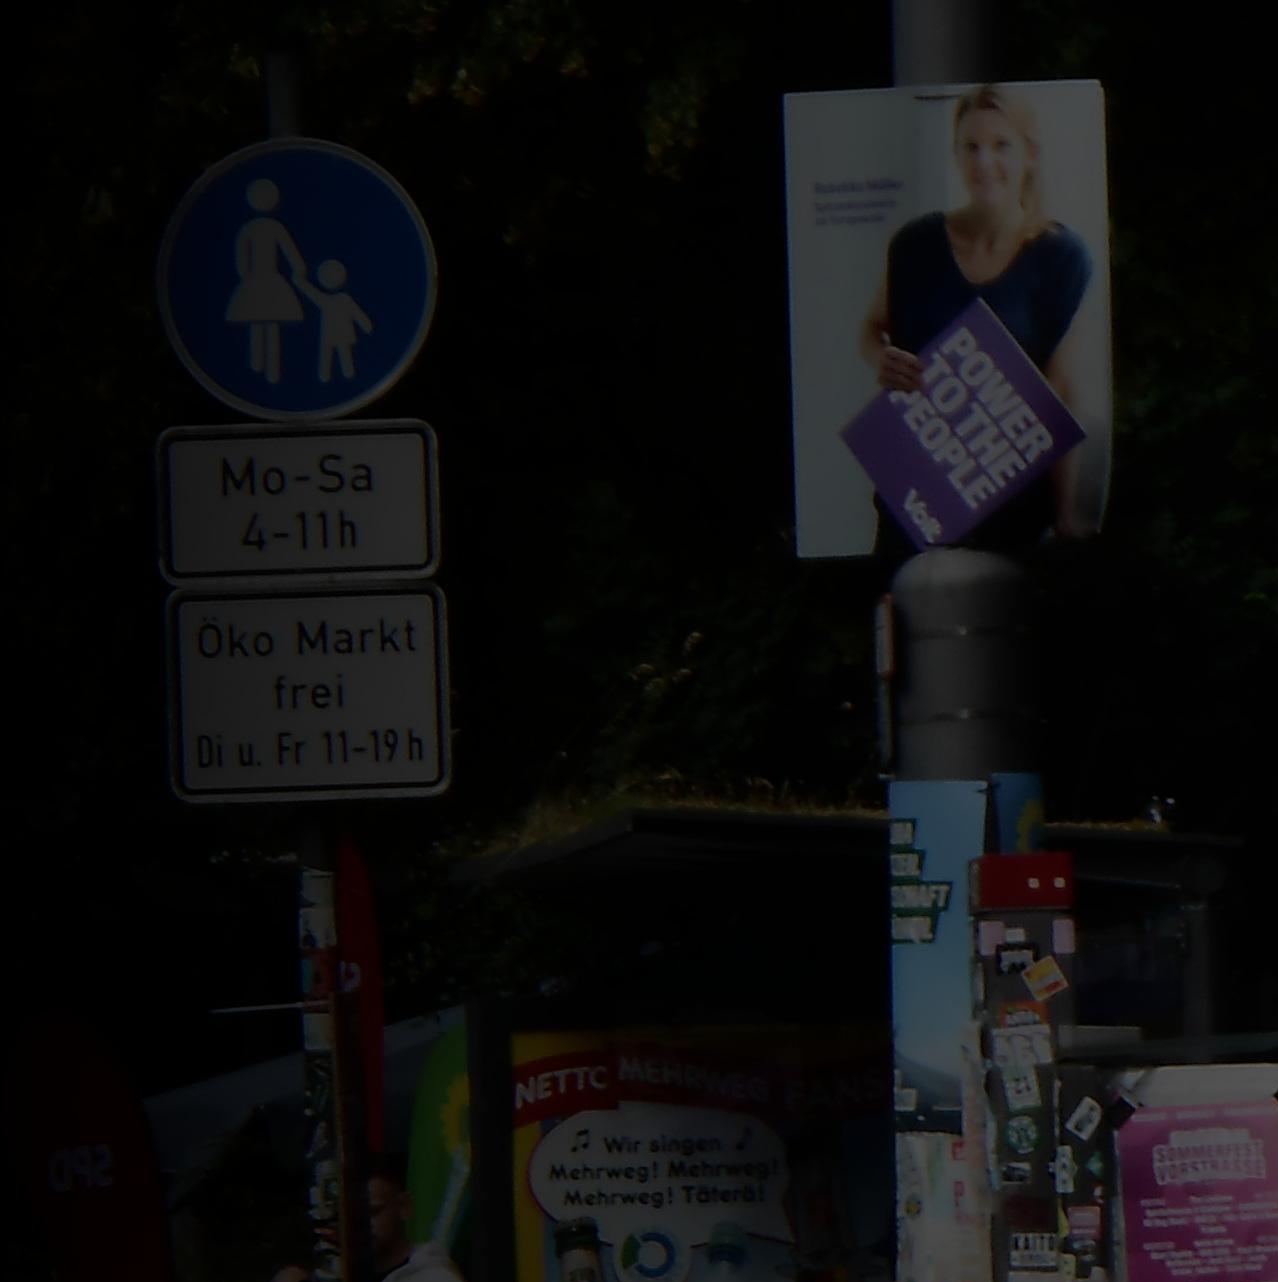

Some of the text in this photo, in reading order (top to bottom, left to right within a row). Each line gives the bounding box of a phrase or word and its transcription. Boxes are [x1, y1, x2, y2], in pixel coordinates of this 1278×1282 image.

[942, 325, 1055, 466] POWER
[920, 354, 1029, 490] TO THE
[221, 455, 374, 497] Mo-Sa
[241, 511, 359, 552] 4-11h
[198, 617, 418, 659] Öko Markt
[273, 674, 346, 710] frei
[197, 732, 224, 769] Di
[238, 740, 264, 768] u.
[278, 730, 306, 766] Fr
[618, 1055, 770, 1103] MEHRWEG
[604, 1134, 721, 1156] Wir singen
[548, 1157, 779, 1182] Mehrweg! Mehrweg!
[563, 1183, 765, 1207] Mehrweg! Täterä!
